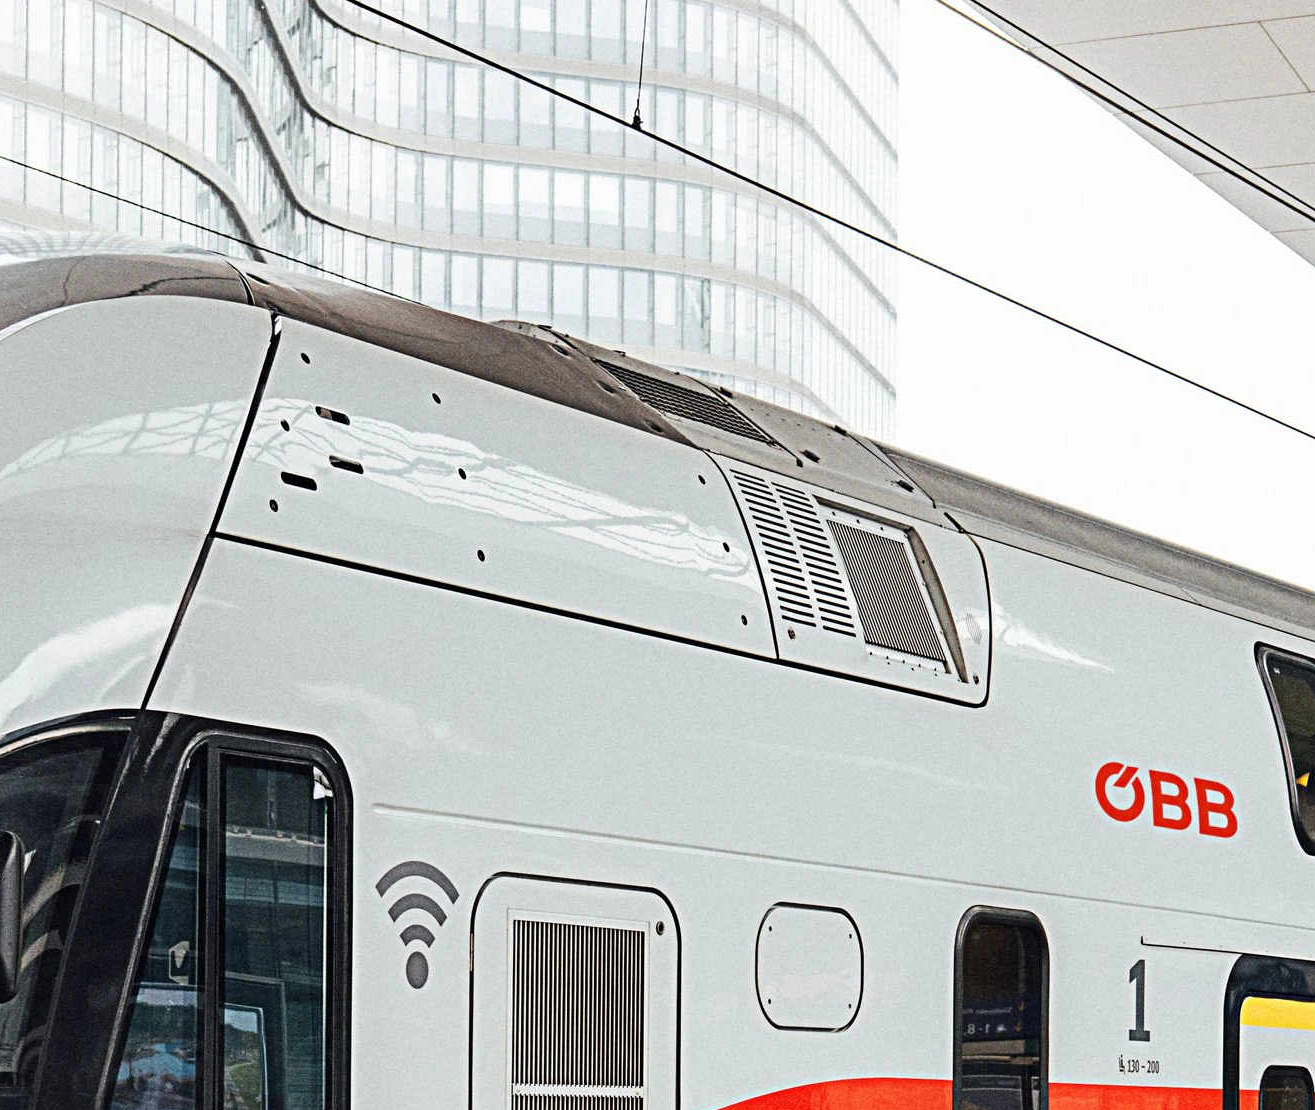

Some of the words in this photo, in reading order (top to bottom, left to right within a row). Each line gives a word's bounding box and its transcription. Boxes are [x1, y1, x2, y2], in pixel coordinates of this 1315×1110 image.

[1095, 761, 1238, 839] ÖBB
[1129, 959, 1151, 1042] 1
[1127, 1059, 1140, 1073] 130
[1147, 1060, 1160, 1074] 200
